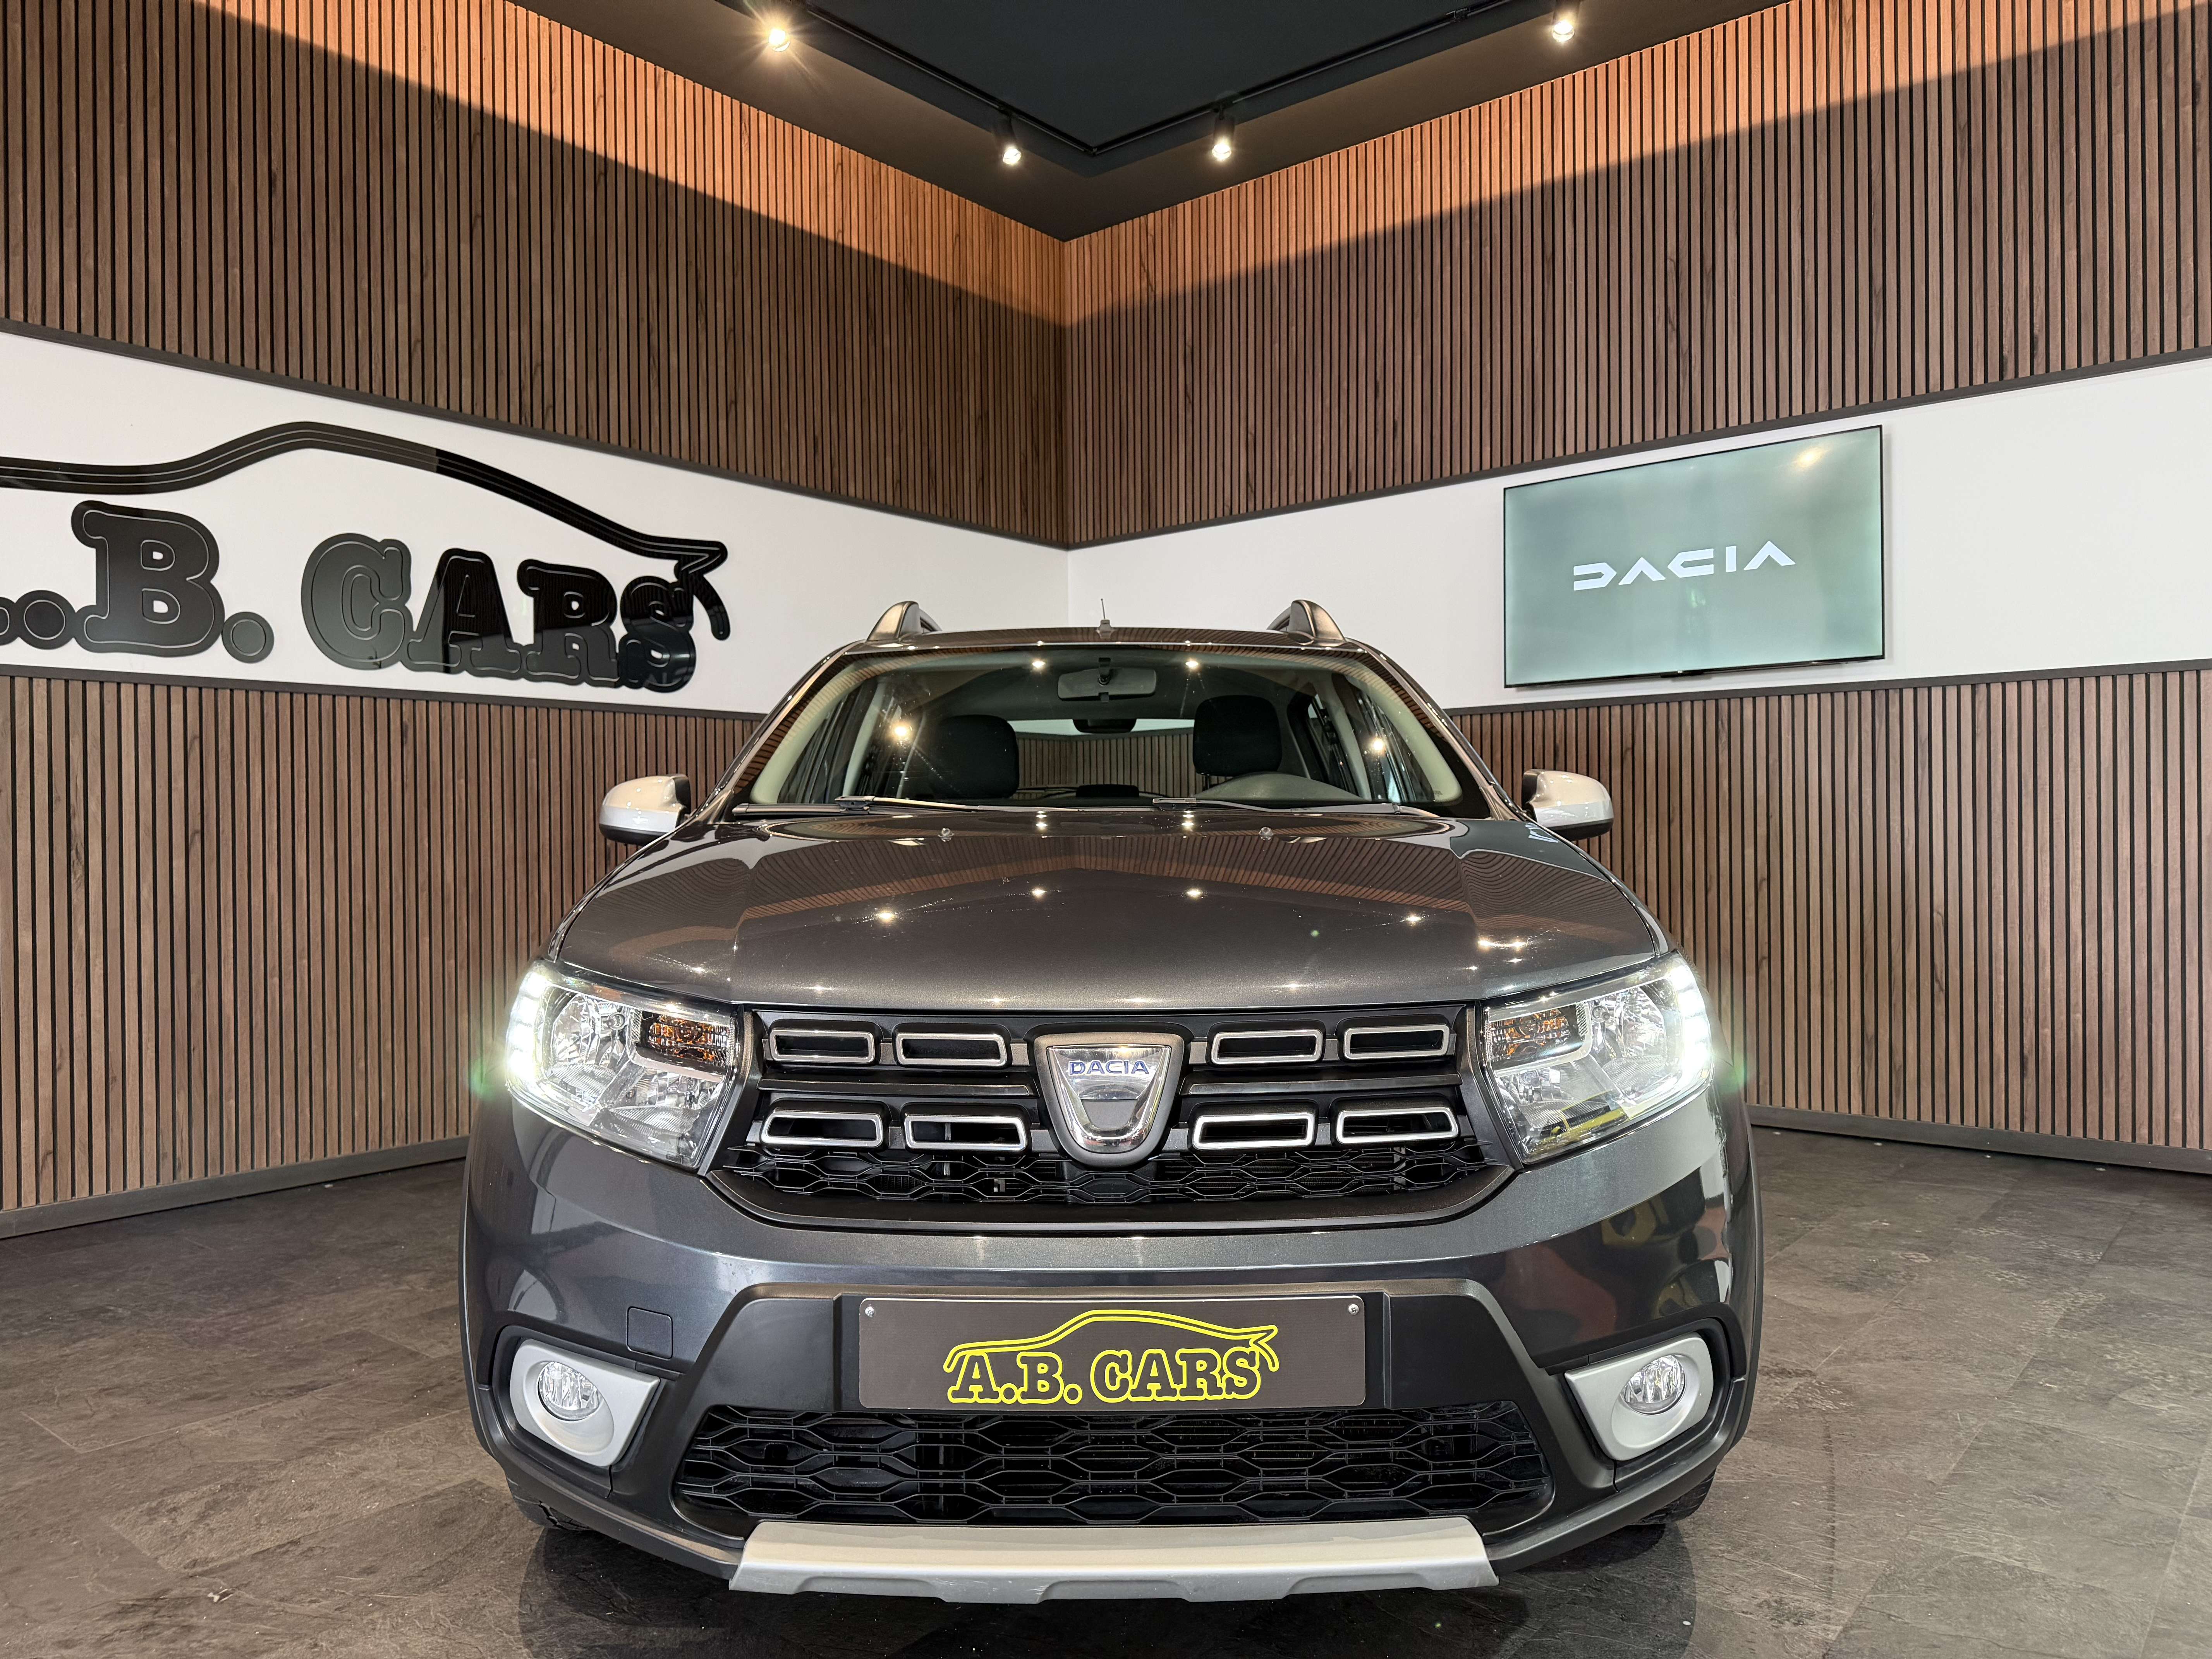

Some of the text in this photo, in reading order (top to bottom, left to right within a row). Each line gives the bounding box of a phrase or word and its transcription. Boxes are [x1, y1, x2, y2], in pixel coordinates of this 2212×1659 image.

[1573, 541, 1796, 591] DACIA
[0, 501, 696, 693] .B. CARS
[1069, 1060, 1150, 1075] DACIA
[947, 1346, 1261, 1405] A.B. CARS
